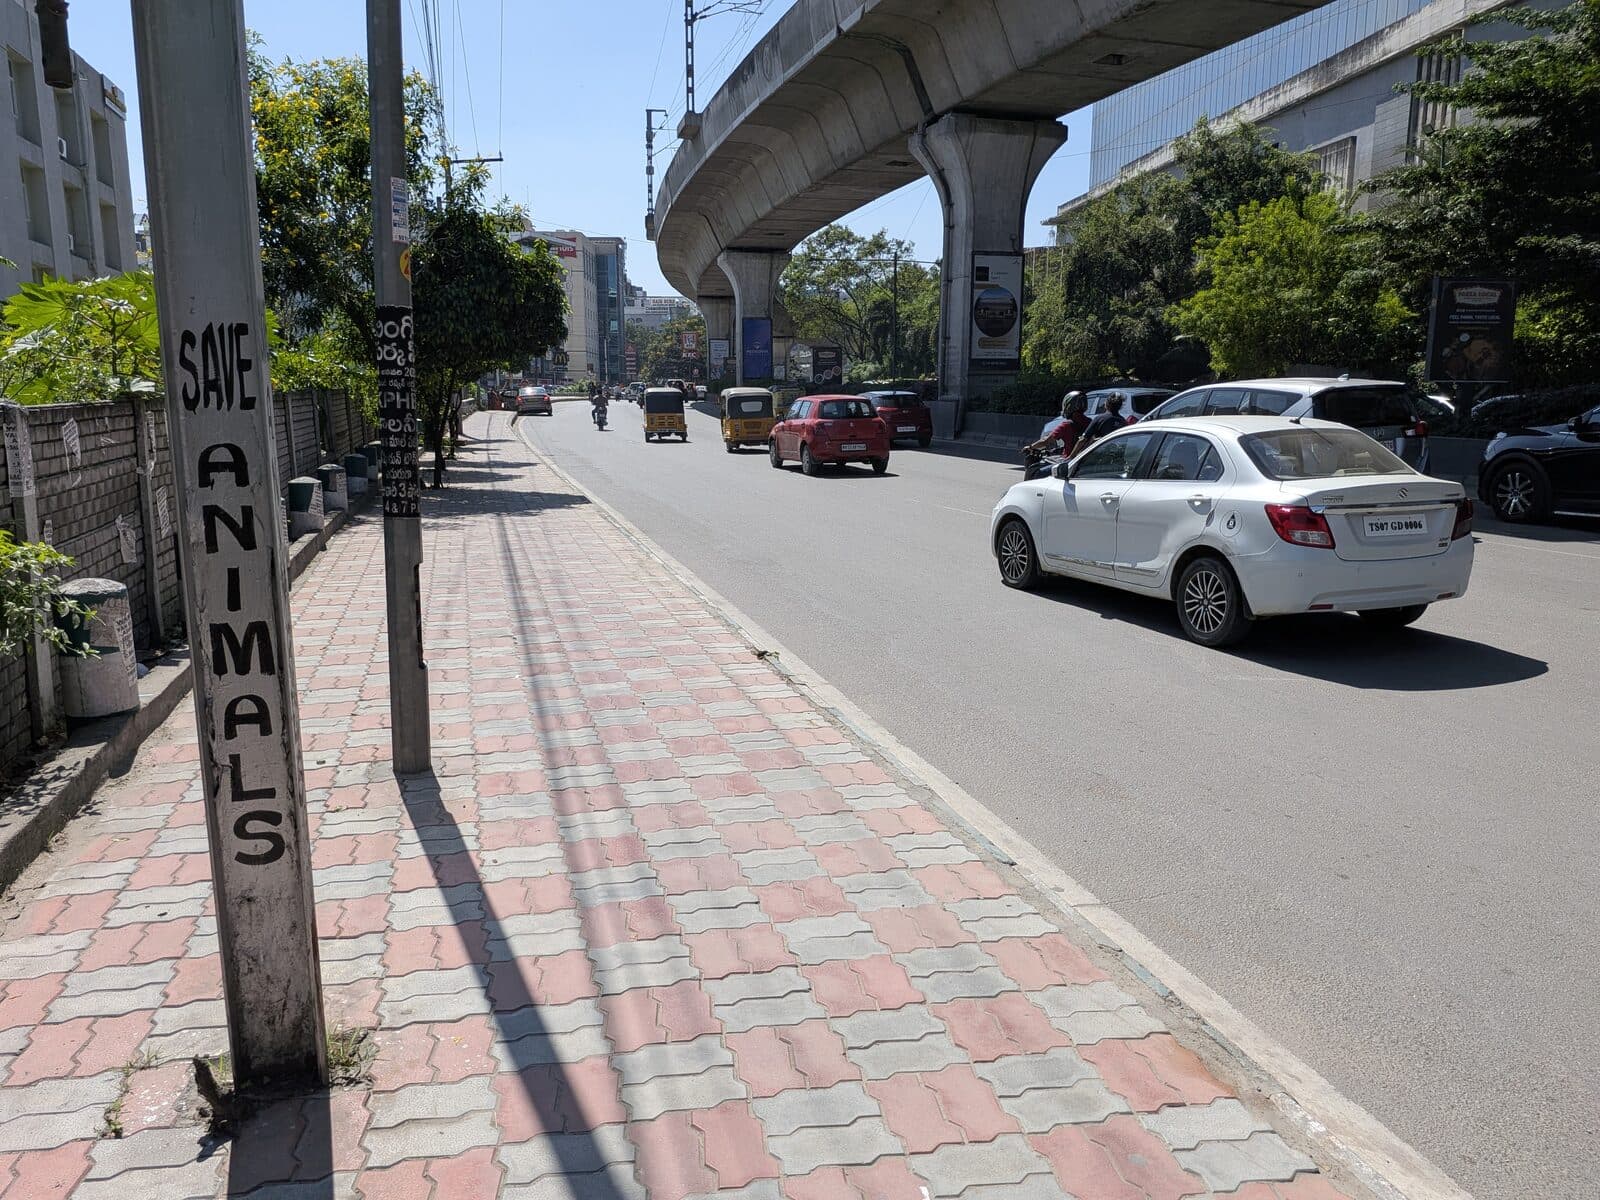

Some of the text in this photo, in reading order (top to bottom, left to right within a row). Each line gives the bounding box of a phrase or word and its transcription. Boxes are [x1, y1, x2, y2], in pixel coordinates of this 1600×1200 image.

[179, 322, 256, 414] SAVE
[1368, 522, 1388, 531] TS07
[1390, 521, 1403, 530] GD
[198, 443, 286, 866] ANIMALS
